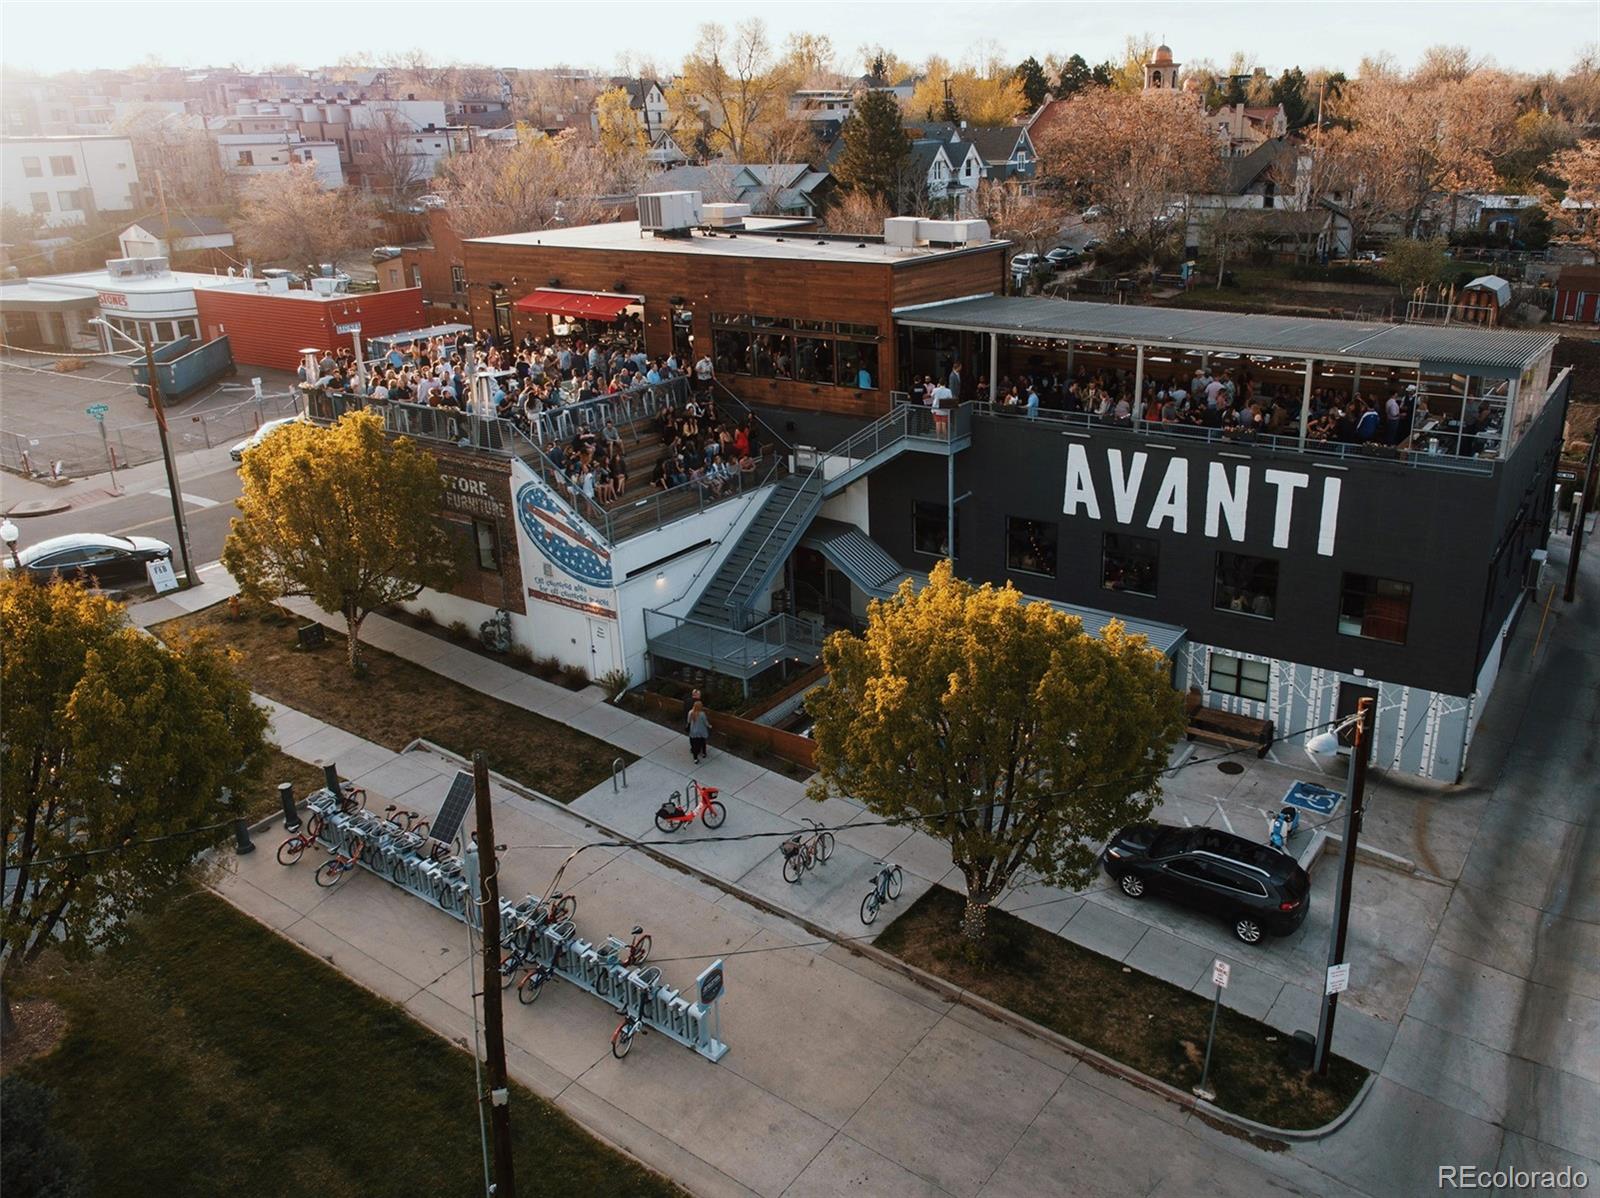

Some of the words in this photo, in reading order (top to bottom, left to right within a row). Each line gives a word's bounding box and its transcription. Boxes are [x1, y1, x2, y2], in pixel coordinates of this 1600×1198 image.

[98, 293, 128, 306] STONES
[440, 474, 488, 496] STORE
[446, 491, 506, 518] FURNITURE
[1063, 444, 1341, 556] AVANTI
